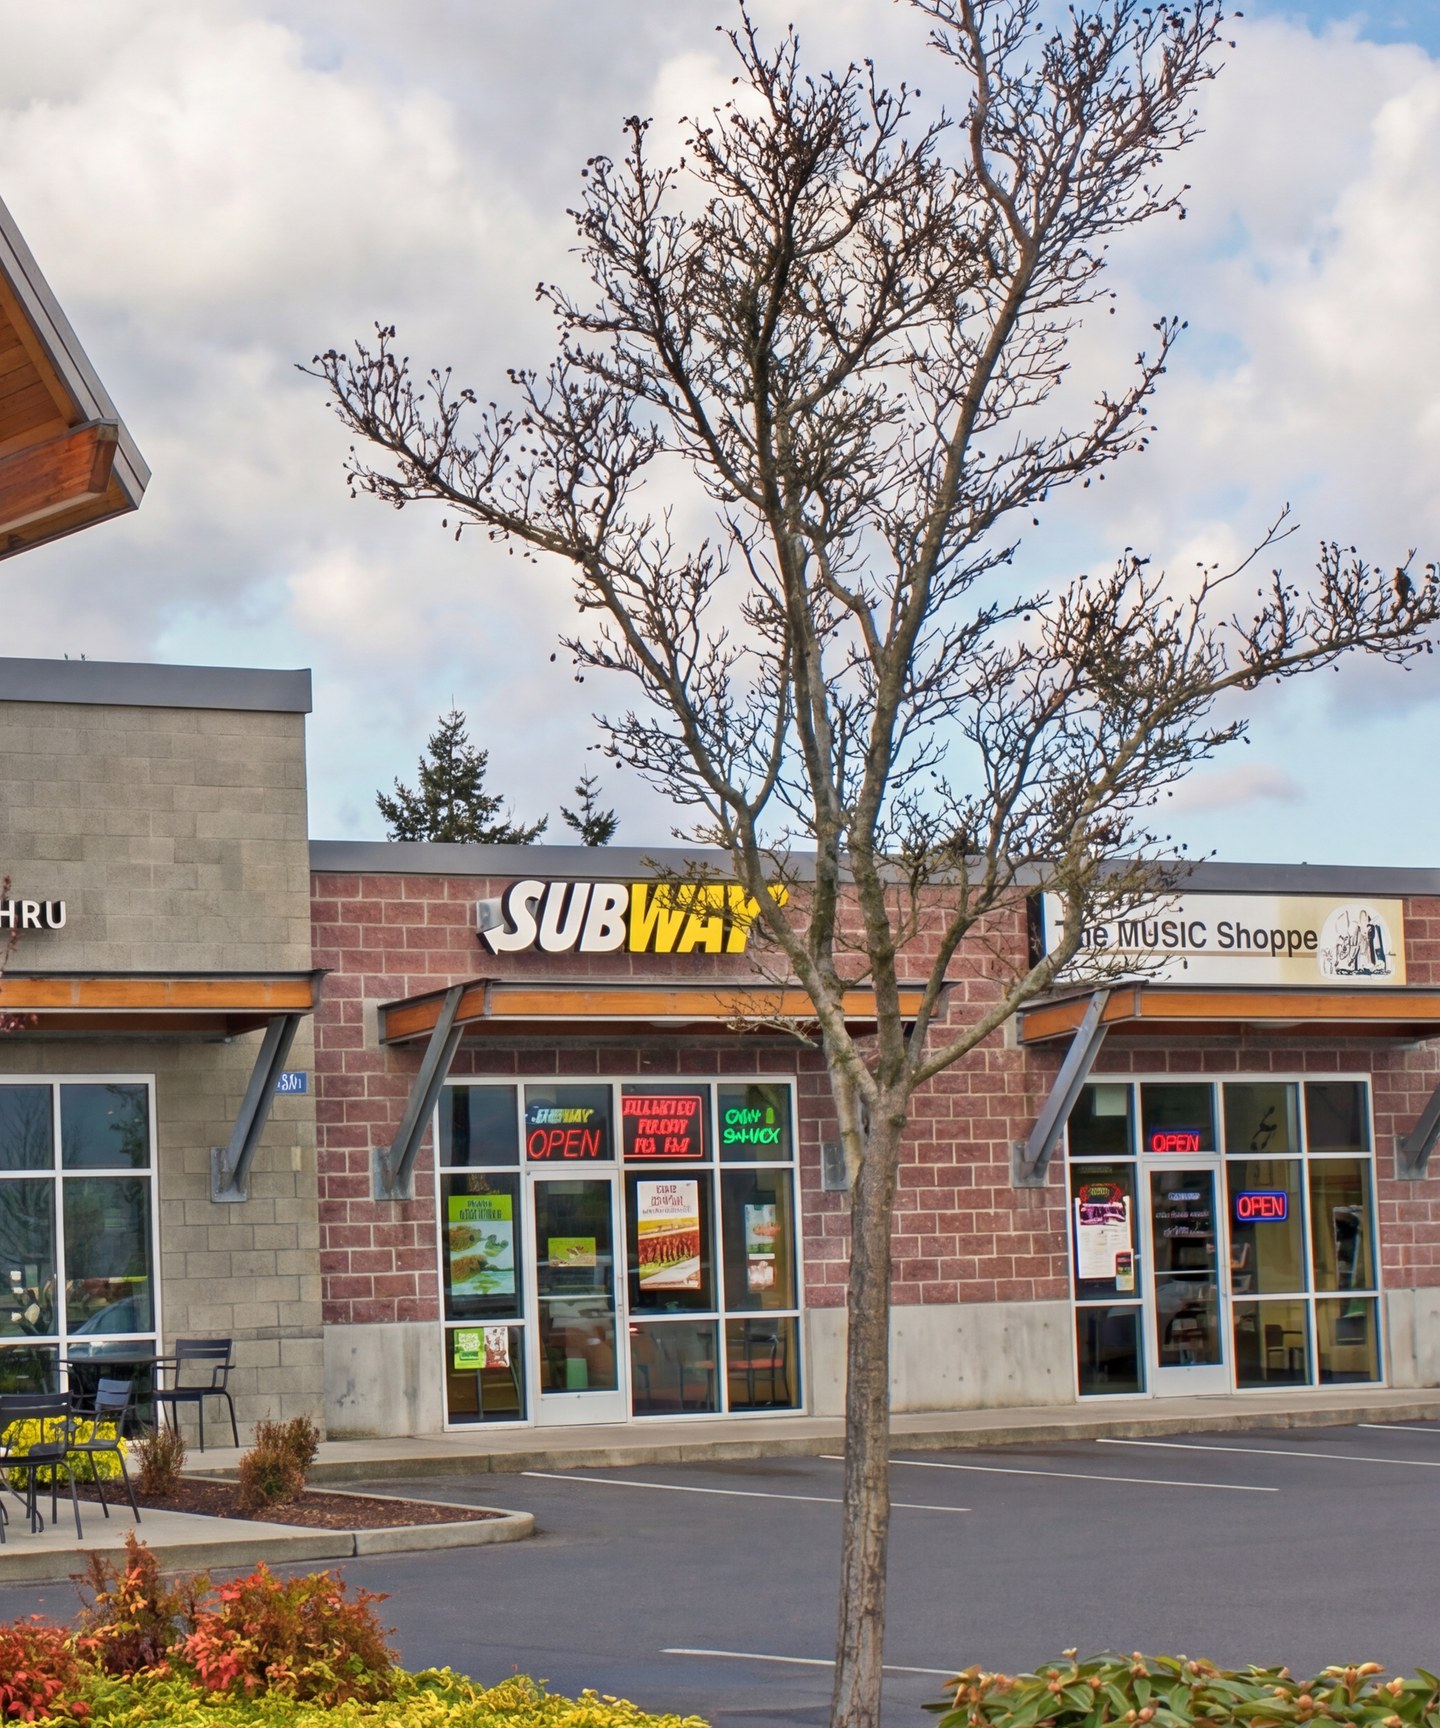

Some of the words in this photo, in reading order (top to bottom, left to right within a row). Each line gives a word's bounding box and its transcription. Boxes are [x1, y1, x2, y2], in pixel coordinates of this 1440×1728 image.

[483, 880, 789, 955] SUBWAY
[1118, 920, 1208, 949] MUSIC
[1217, 921, 1319, 957] Shoppe
[527, 1128, 601, 1159] OPEN
[1152, 1133, 1200, 1152] OPEN
[1238, 1195, 1284, 1217] OPEN
